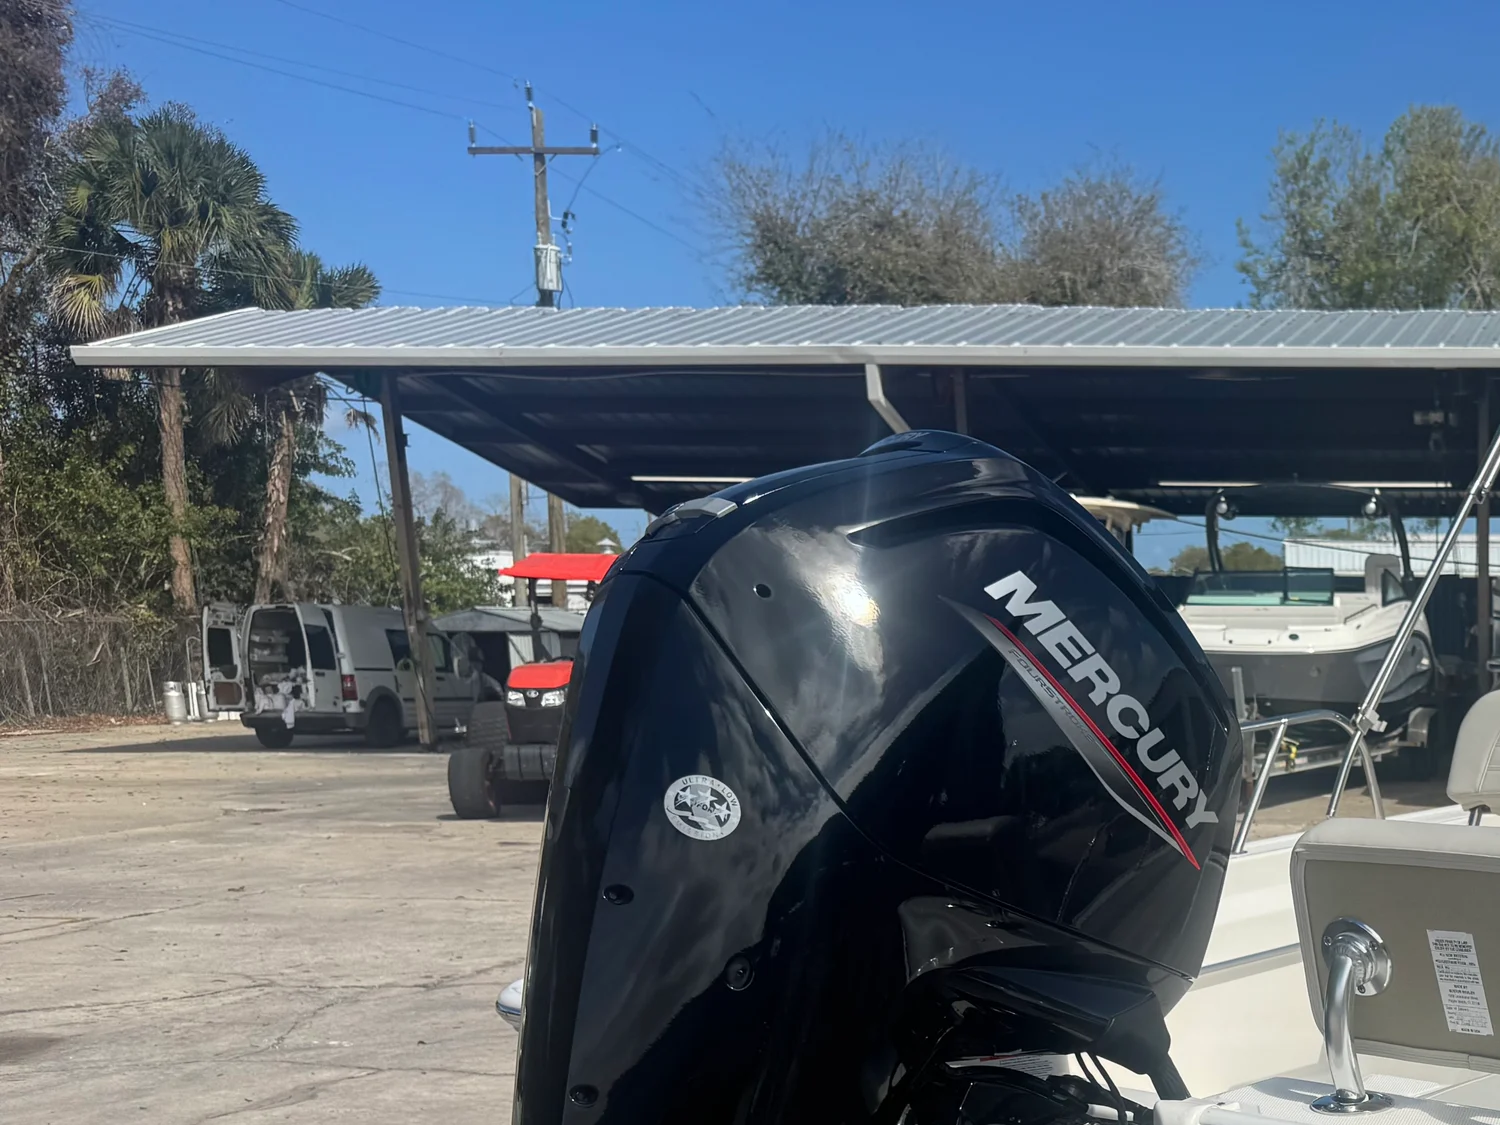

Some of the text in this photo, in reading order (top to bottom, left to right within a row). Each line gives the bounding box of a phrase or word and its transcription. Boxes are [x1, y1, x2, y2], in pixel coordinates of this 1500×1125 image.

[984, 570, 1219, 829] MERCURY
[1008, 648, 1097, 743] FOURSTROKE
[681, 777, 738, 806] ULTRA LOW
